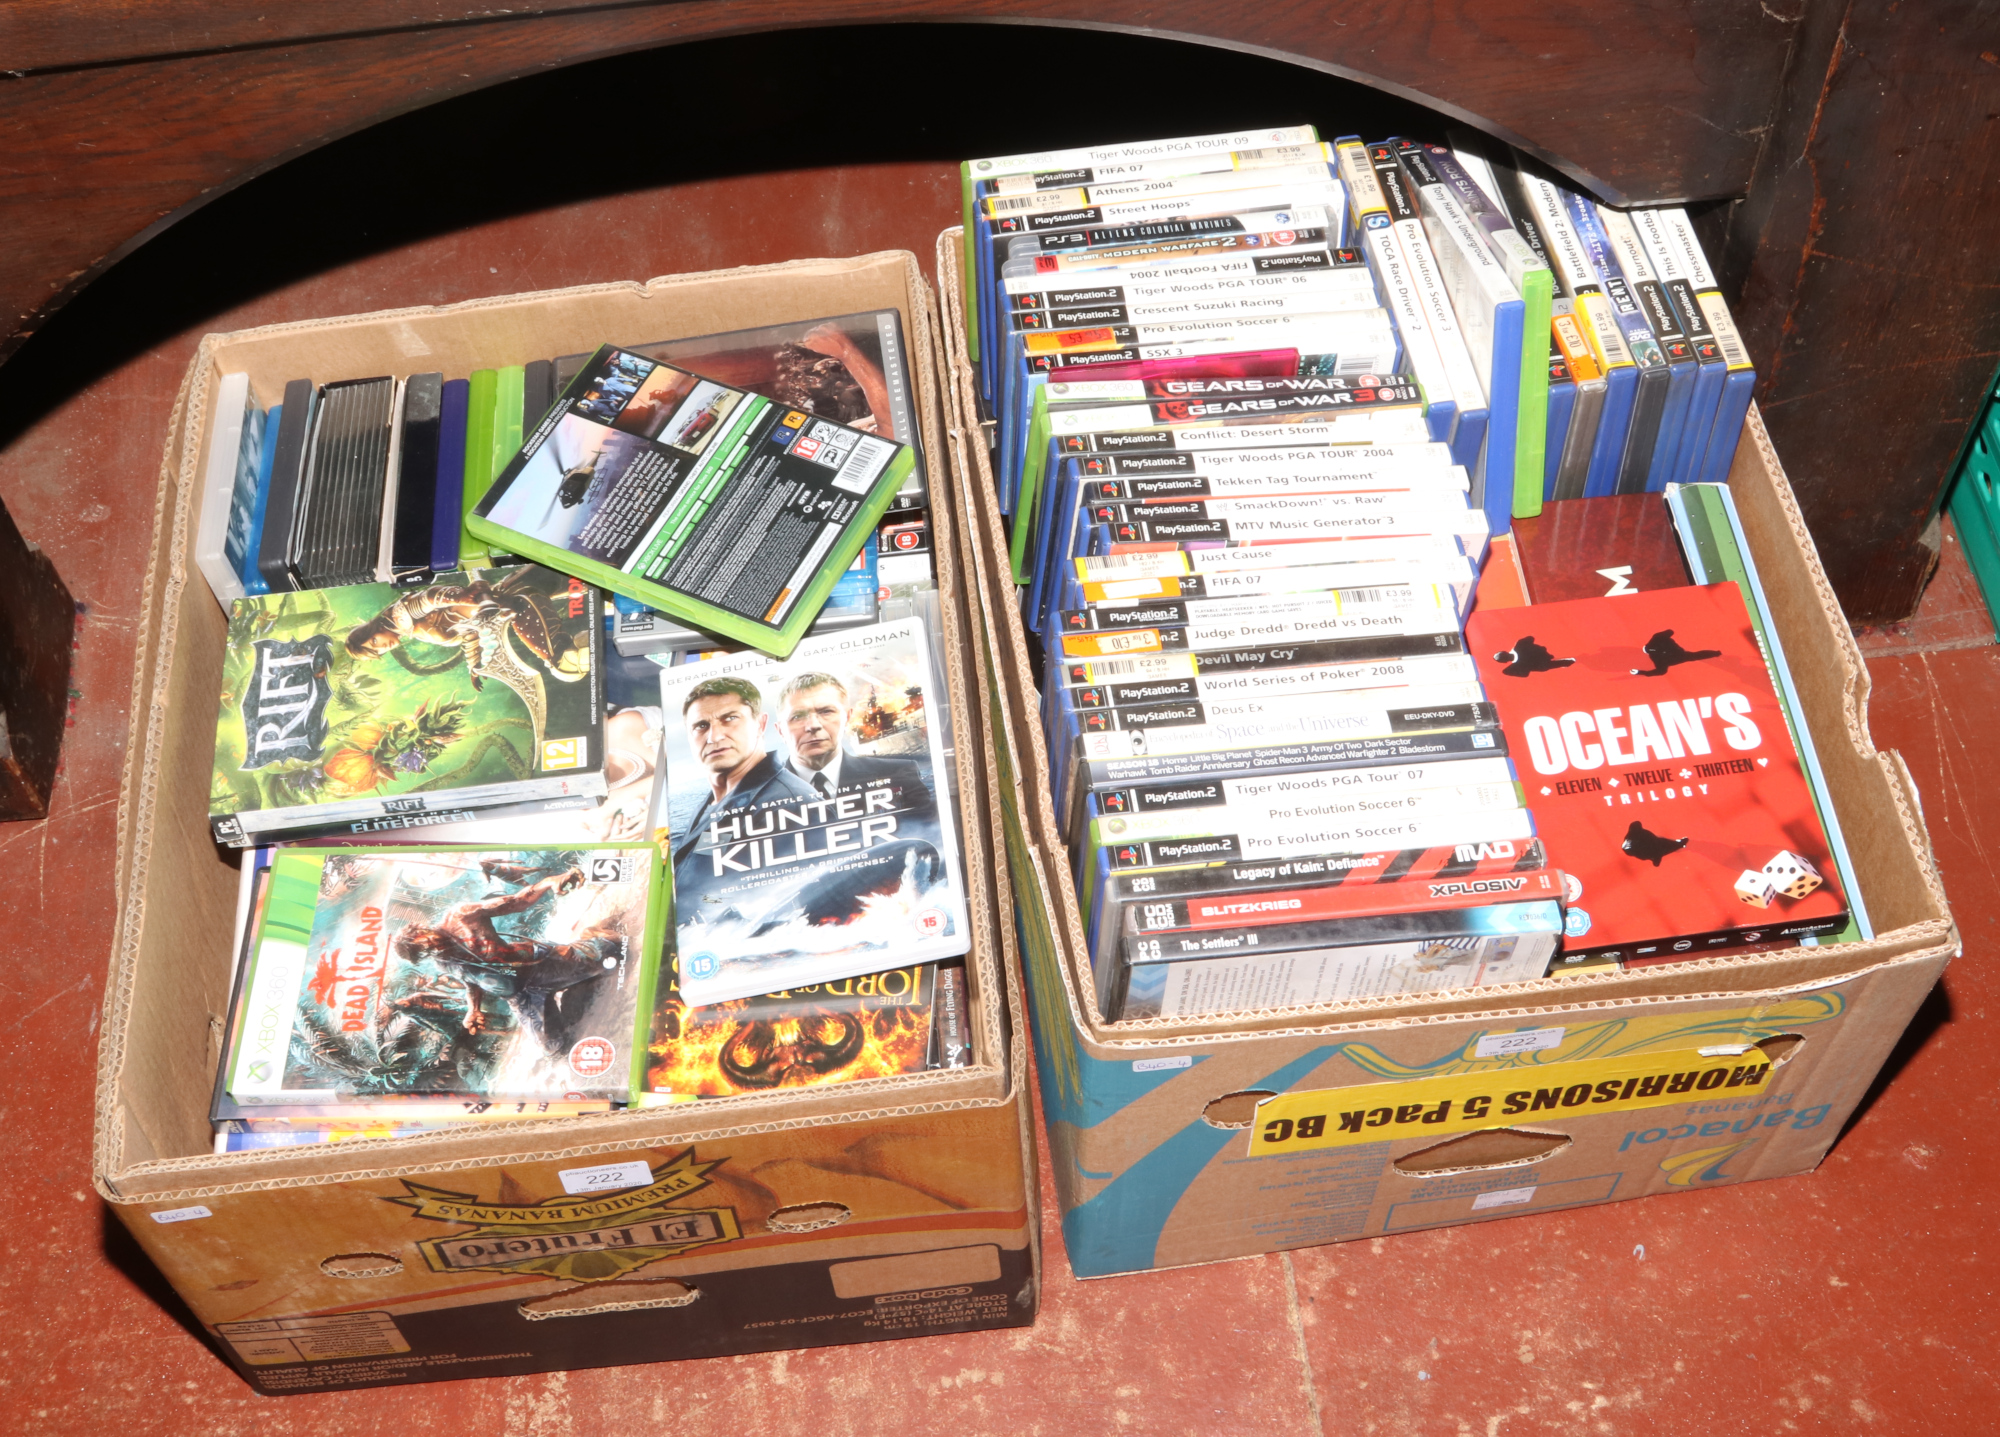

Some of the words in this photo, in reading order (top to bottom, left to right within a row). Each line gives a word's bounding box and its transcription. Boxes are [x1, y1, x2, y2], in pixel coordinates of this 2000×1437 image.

[1088, 149, 1119, 161] Tiger
[1123, 146, 1163, 158] Woods
[1167, 141, 1192, 152] PGA
[1195, 138, 1229, 148] TOUR
[1234, 136, 1249, 145] 09
[1277, 146, 1300, 154] £3.99
[1099, 166, 1126, 175] FIFA
[1129, 164, 1143, 173] 07
[1036, 194, 1060, 202] £2.99
[1096, 184, 1136, 196] Athens
[1139, 181, 1172, 191] 2004
[1540, 182, 1560, 217] Modern
[1035, 211, 1095, 226] PlayStation.2
[1109, 205, 1147, 215] Street
[1151, 200, 1190, 212] Hoops
[1094, 226, 1137, 240] ALIENS
[1141, 222, 1184, 236] COLONIAL
[1191, 218, 1232, 231] MARINES
[1432, 186, 1445, 201] Tony
[1442, 200, 1462, 225] Hawk's
[1458, 223, 1493, 266] Underground
[1555, 219, 1566, 229] 2:
[1103, 248, 1157, 258] MODERN
[1161, 240, 1219, 253] WARFARE
[1221, 236, 1237, 248] 2
[1558, 230, 1586, 279] Battlefield
[1677, 224, 1706, 283] Chessmaster
[1222, 262, 1248, 272] FIFA
[1261, 251, 1321, 267] PlayStation.2
[1130, 270, 1159, 279] 2004
[1164, 265, 1218, 277] Football
[1379, 235, 1395, 261] TOCA
[1389, 263, 1402, 286] Race
[1398, 287, 1415, 318] Driver
[1404, 223, 1415, 240] Pro
[1410, 242, 1434, 289] Evolution
[1429, 291, 1447, 323] Soccer
[1133, 286, 1166, 298] Tiger
[1170, 282, 1208, 294] Woods
[1218, 279, 1245, 289] PGA
[1248, 277, 1282, 287] TOUR
[1291, 275, 1307, 284] 06
[1607, 280, 1637, 313] RENT
[1058, 309, 1120, 322] PlayStation.2
[1134, 304, 1189, 315] Crescent
[1194, 301, 1236, 311] Suzuki
[1240, 298, 1283, 309] Racing
[1713, 313, 1726, 331] £3.99
[885, 323, 902, 401] REMASTERED
[1147, 349, 1174, 358] SSX
[1175, 348, 1183, 356] 3
[1167, 379, 1264, 393] GEARS
[1188, 399, 1277, 416] GEARS
[1295, 392, 1353, 405] WAR
[1353, 389, 1376, 402] 3
[1180, 431, 1237, 441] Conflict:
[1241, 427, 1283, 437] Desert
[1288, 425, 1329, 434] Storm
[796, 438, 819, 456] 18
[1138, 479, 1202, 492] PlayStation.2
[1216, 476, 1262, 486] Tekken
[1267, 475, 1289, 486] Tag
[1293, 472, 1374, 483] Tournament
[1234, 498, 1323, 510] SmackDown!
[1333, 497, 1351, 506] vs.
[1355, 496, 1383, 505] Raw
[1155, 522, 1221, 535] PlayStation.2
[1235, 521, 1264, 530] MTV
[1270, 519, 1309, 529] Music
[1314, 517, 1381, 528] Generator
[1132, 552, 1158, 561] £2.99
[1200, 553, 1228, 563] Just
[1231, 550, 1272, 560] Cause
[1386, 589, 1412, 597] £3.99
[1194, 629, 1235, 640] Judge
[1239, 624, 1284, 635] Dredd
[1295, 619, 1337, 631] Dredd
[1342, 618, 1356, 627] vs
[1362, 616, 1403, 626] Death
[804, 644, 836, 657] GARY
[840, 629, 911, 650] OLDMAN
[1140, 658, 1166, 666] £2.99
[1235, 652, 1266, 663] May
[1270, 650, 1295, 660] Cry
[667, 669, 718, 686] GERARD
[1204, 678, 1248, 690] World
[1253, 675, 1296, 686] Series
[1301, 672, 1315, 681] of
[1321, 669, 1361, 680] Poker
[1372, 666, 1404, 675] 2008
[254, 648, 319, 758] RIFT
[1211, 706, 1244, 715] Deus
[1249, 704, 1264, 712] Ex
[1127, 708, 1196, 723] PlayStation.2
[1216, 723, 1265, 743] Space
[1299, 714, 1369, 732] Universe
[1523, 692, 1762, 775] OCEAN'S
[545, 741, 575, 769] 12
[1108, 769, 1147, 779] Warhawk
[1150, 766, 1174, 775] Tomb
[1175, 764, 1201, 773] Raider
[1202, 760, 1250, 771] Anniversary
[1253, 757, 1278, 767] Ghost
[1556, 777, 1602, 796] ELEVEN
[1624, 769, 1673, 787] TWELVE
[1694, 758, 1754, 778] THIRTEEN
[1235, 784, 1272, 796] Tiger
[1277, 778, 1327, 791] Woods
[1332, 775, 1362, 786] PGA
[1367, 772, 1399, 782] Tour
[1408, 770, 1424, 780] 07
[385, 799, 423, 812] RIFT
[710, 805, 746, 819] START
[762, 795, 804, 809] BATTLE
[809, 791, 825, 800] TO
[830, 785, 850, 796] WIN
[867, 778, 892, 789] WAR
[1604, 784, 1710, 806] TRILOGY
[710, 788, 896, 843] HUNTER
[1269, 809, 1291, 819] Pro
[1295, 804, 1355, 817] Evolution
[1359, 799, 1403, 811] Soccer
[1408, 797, 1416, 807] 6
[712, 816, 900, 877] KILLER
[1455, 840, 1515, 862] MAD
[620, 857, 628, 882] DEEP
[627, 857, 636, 882] SILVER
[1233, 867, 1275, 880] Legacy
[1279, 865, 1292, 875] of
[1294, 863, 1325, 873] Kain:
[1329, 857, 1380, 871] Defiance
[1430, 878, 1522, 897] XPLOSIV
[1201, 899, 1301, 916] BLITZKRIEG
[1566, 915, 1582, 929] 12
[354, 906, 385, 982] ISLAND
[1181, 939, 1200, 951] The
[1202, 936, 1239, 949] Settlers
[1247, 934, 1258, 945] III
[617, 935, 629, 991] TECHLAND
[342, 983, 370, 1033] DEAD
[1500, 1037, 1537, 1048] 222
[580, 1045, 605, 1070] 18
[1502, 1063, 1770, 1116] MORRISONS
[1462, 1096, 1492, 1120] 5
[1686, 1093, 1795, 1116] Bananas
[1338, 1100, 1452, 1133] Pack
[1617, 1103, 1832, 1152] Banacol
[1263, 1115, 1326, 1143] BC
[586, 1172, 624, 1184] 222
[573, 1176, 691, 1216] PREMIUM
[438, 1205, 564, 1220] BANANAS
[649, 1220, 704, 1242] El
[458, 1227, 640, 1258] Frutero
